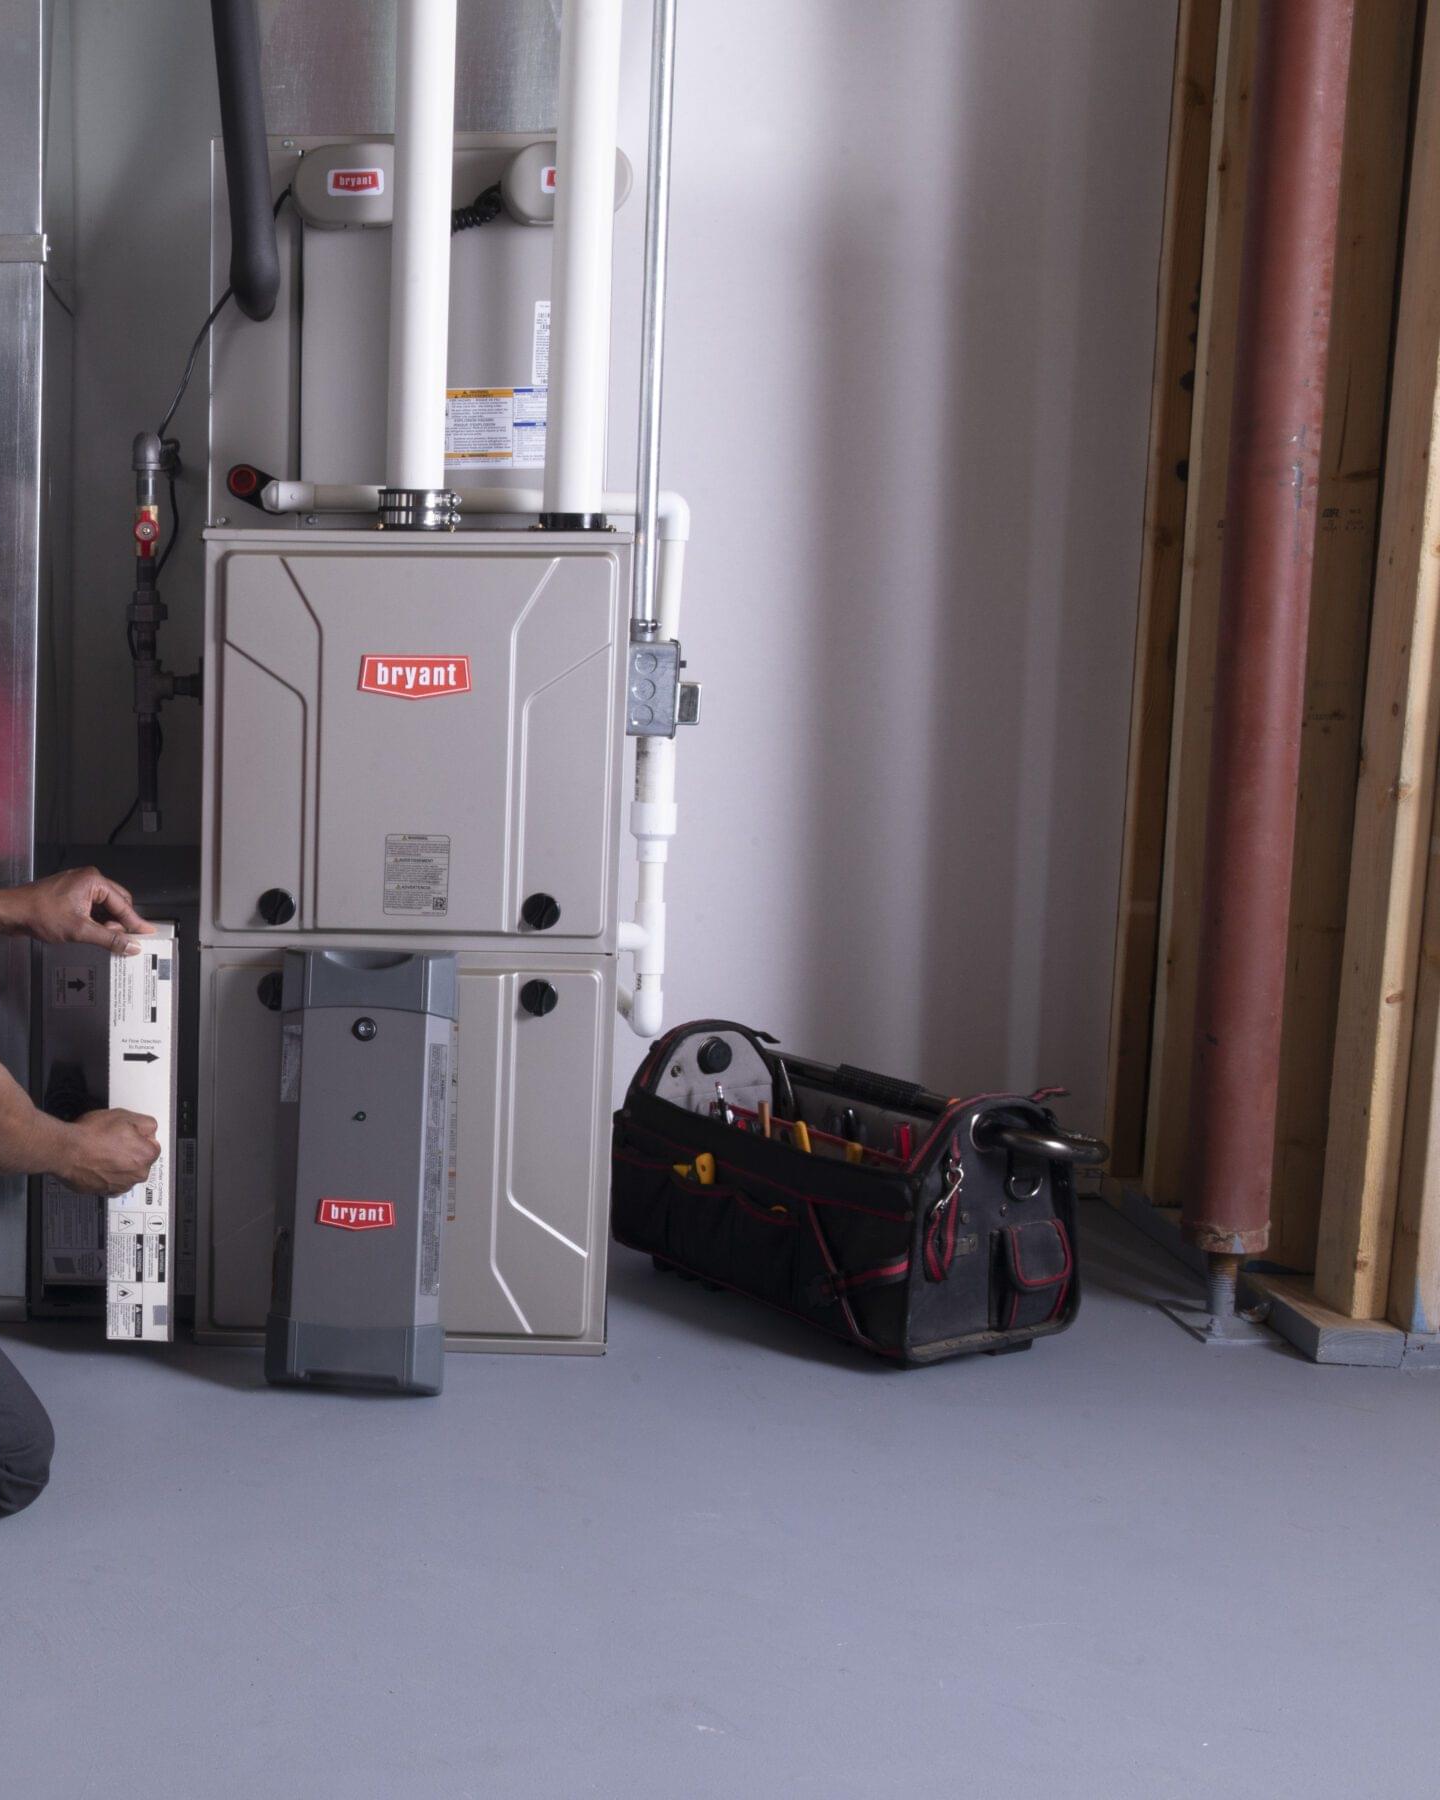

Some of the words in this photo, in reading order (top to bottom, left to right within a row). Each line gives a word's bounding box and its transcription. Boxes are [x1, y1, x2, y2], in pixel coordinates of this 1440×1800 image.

[339, 176, 372, 187] bryant
[377, 662, 457, 689] bryant
[331, 1203, 384, 1223] bryant
